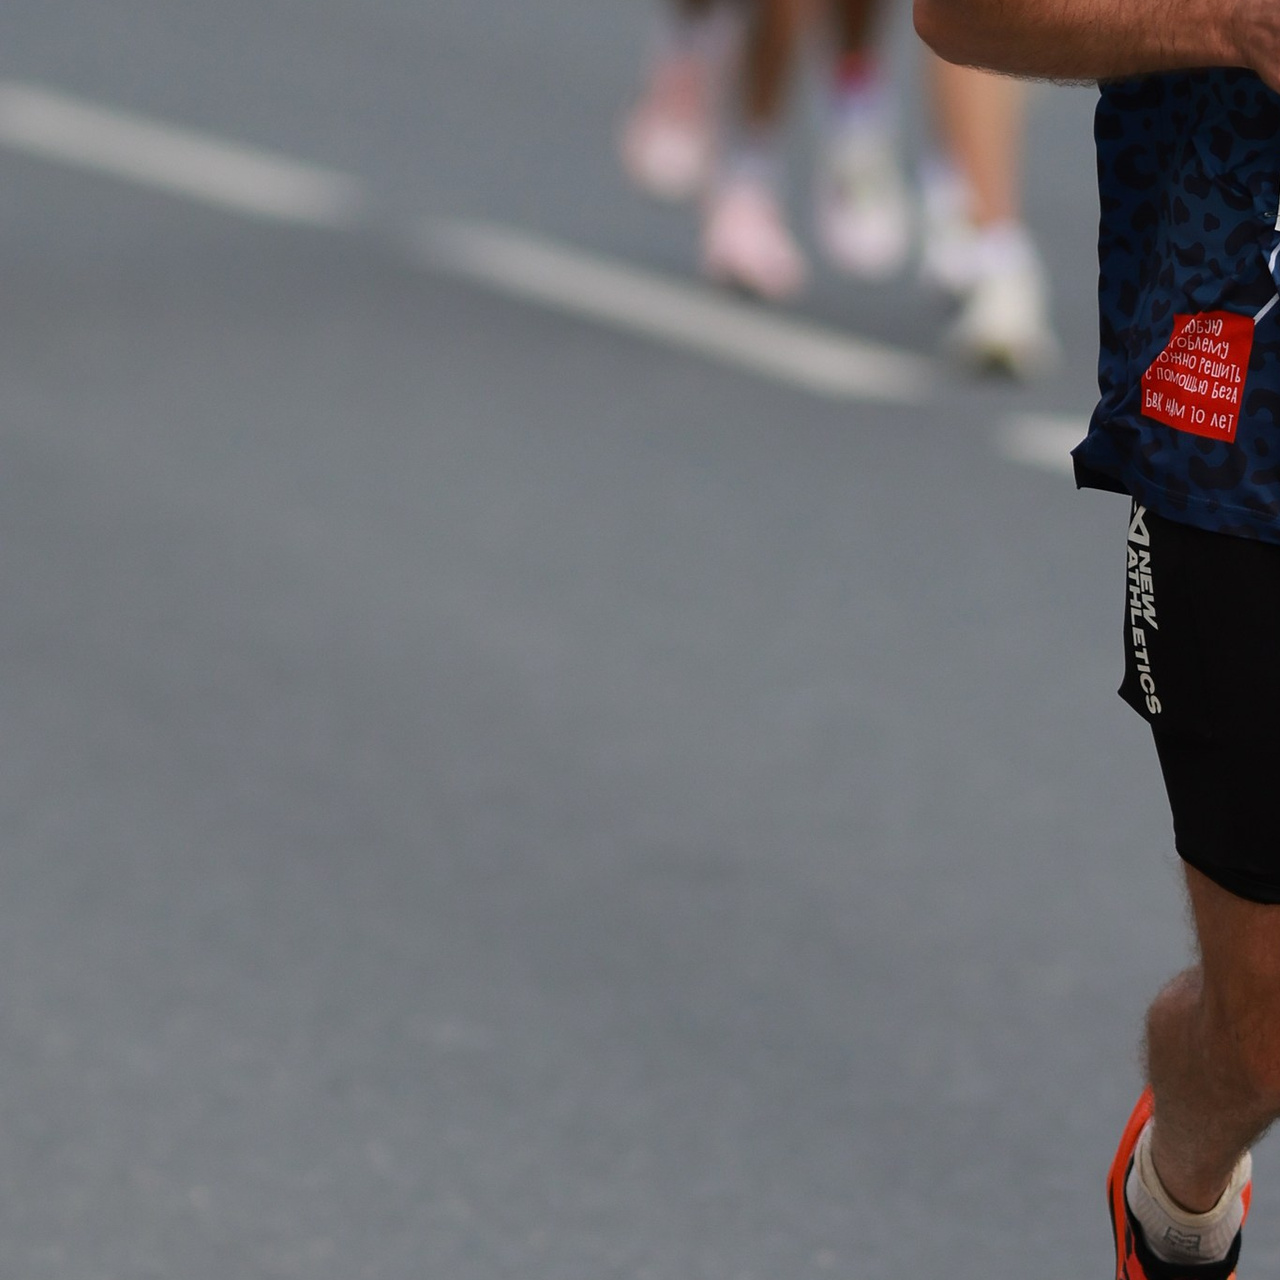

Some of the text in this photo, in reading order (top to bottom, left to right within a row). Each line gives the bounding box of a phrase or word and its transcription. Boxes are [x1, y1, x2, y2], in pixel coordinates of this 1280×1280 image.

[1156, 351, 1197, 370] ОЖНО
[1191, 405, 1206, 424] 10
[1138, 549, 1159, 631] NEW
[1127, 544, 1162, 715] ATHLETICS
